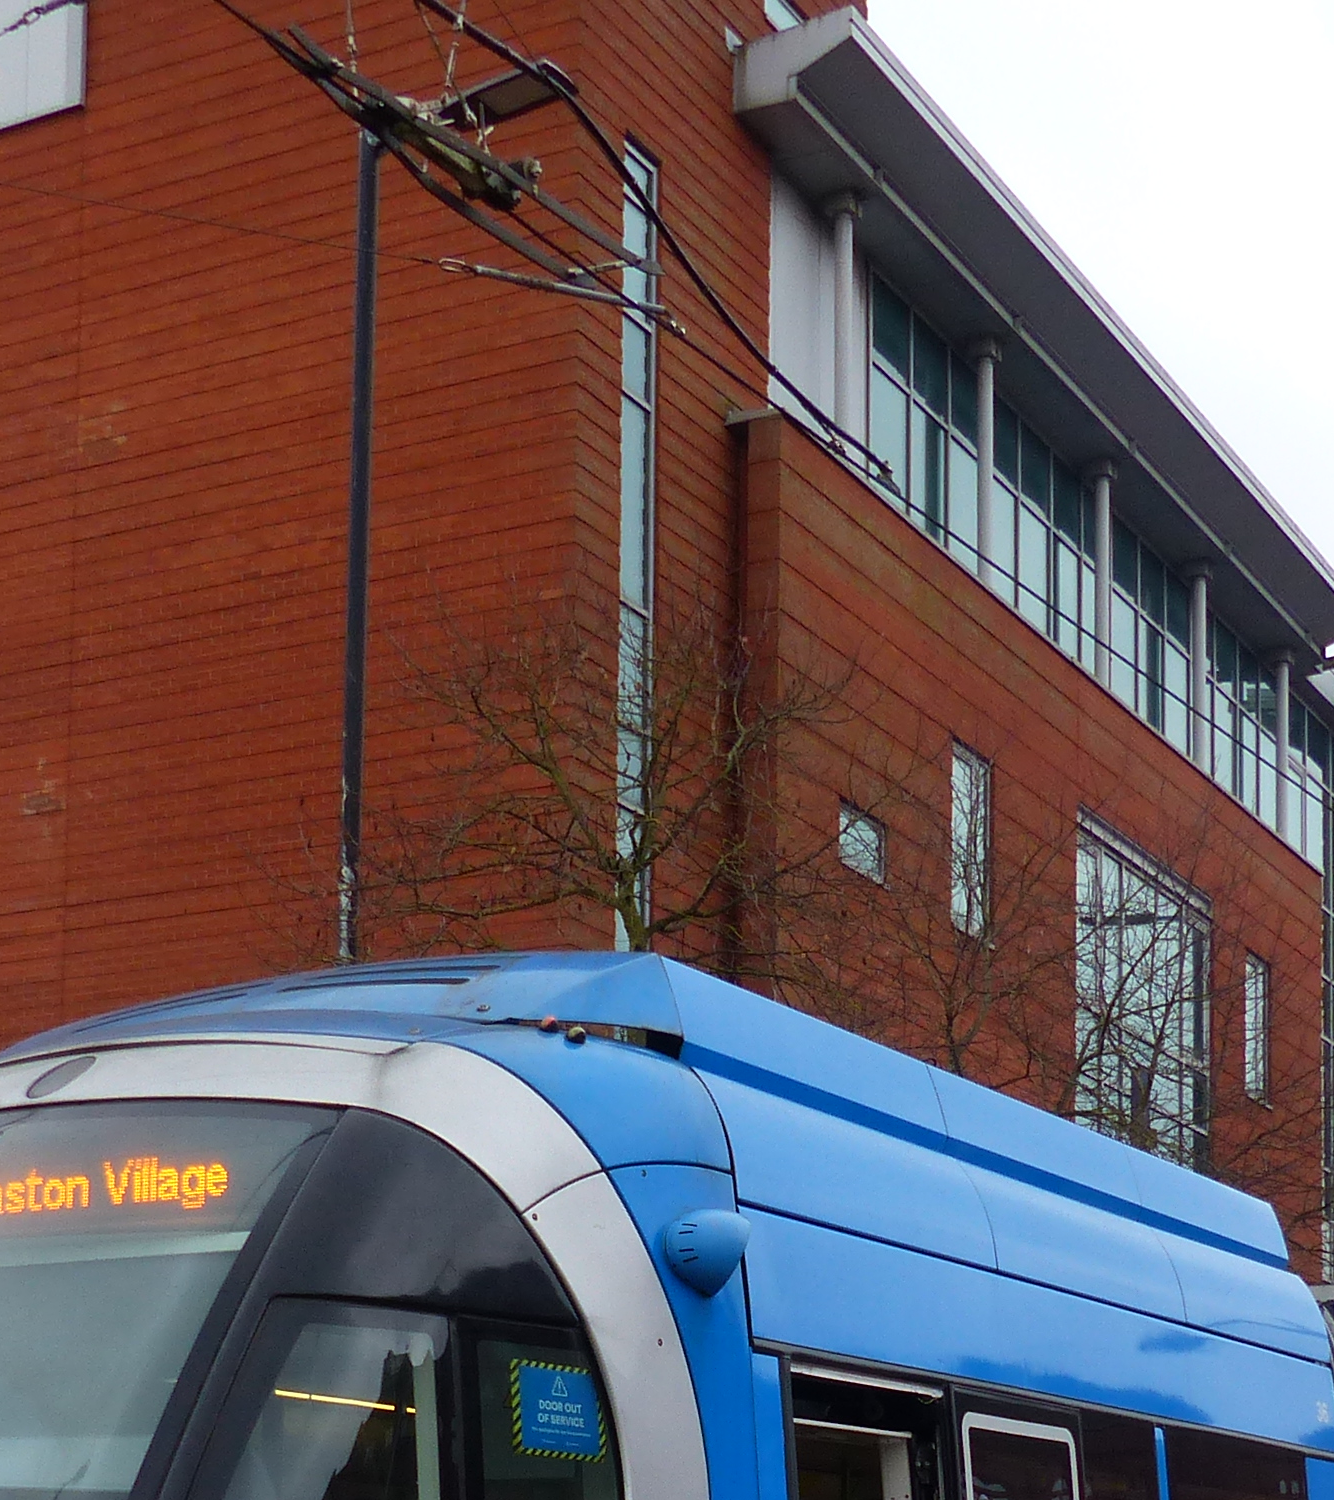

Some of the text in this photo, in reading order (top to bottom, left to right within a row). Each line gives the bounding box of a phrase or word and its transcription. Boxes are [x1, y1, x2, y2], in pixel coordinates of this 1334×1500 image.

[104, 1157, 229, 1209] Village
[539, 1399, 582, 1414] DOOR OUT
[537, 1413, 585, 1428] OF SERVICE
